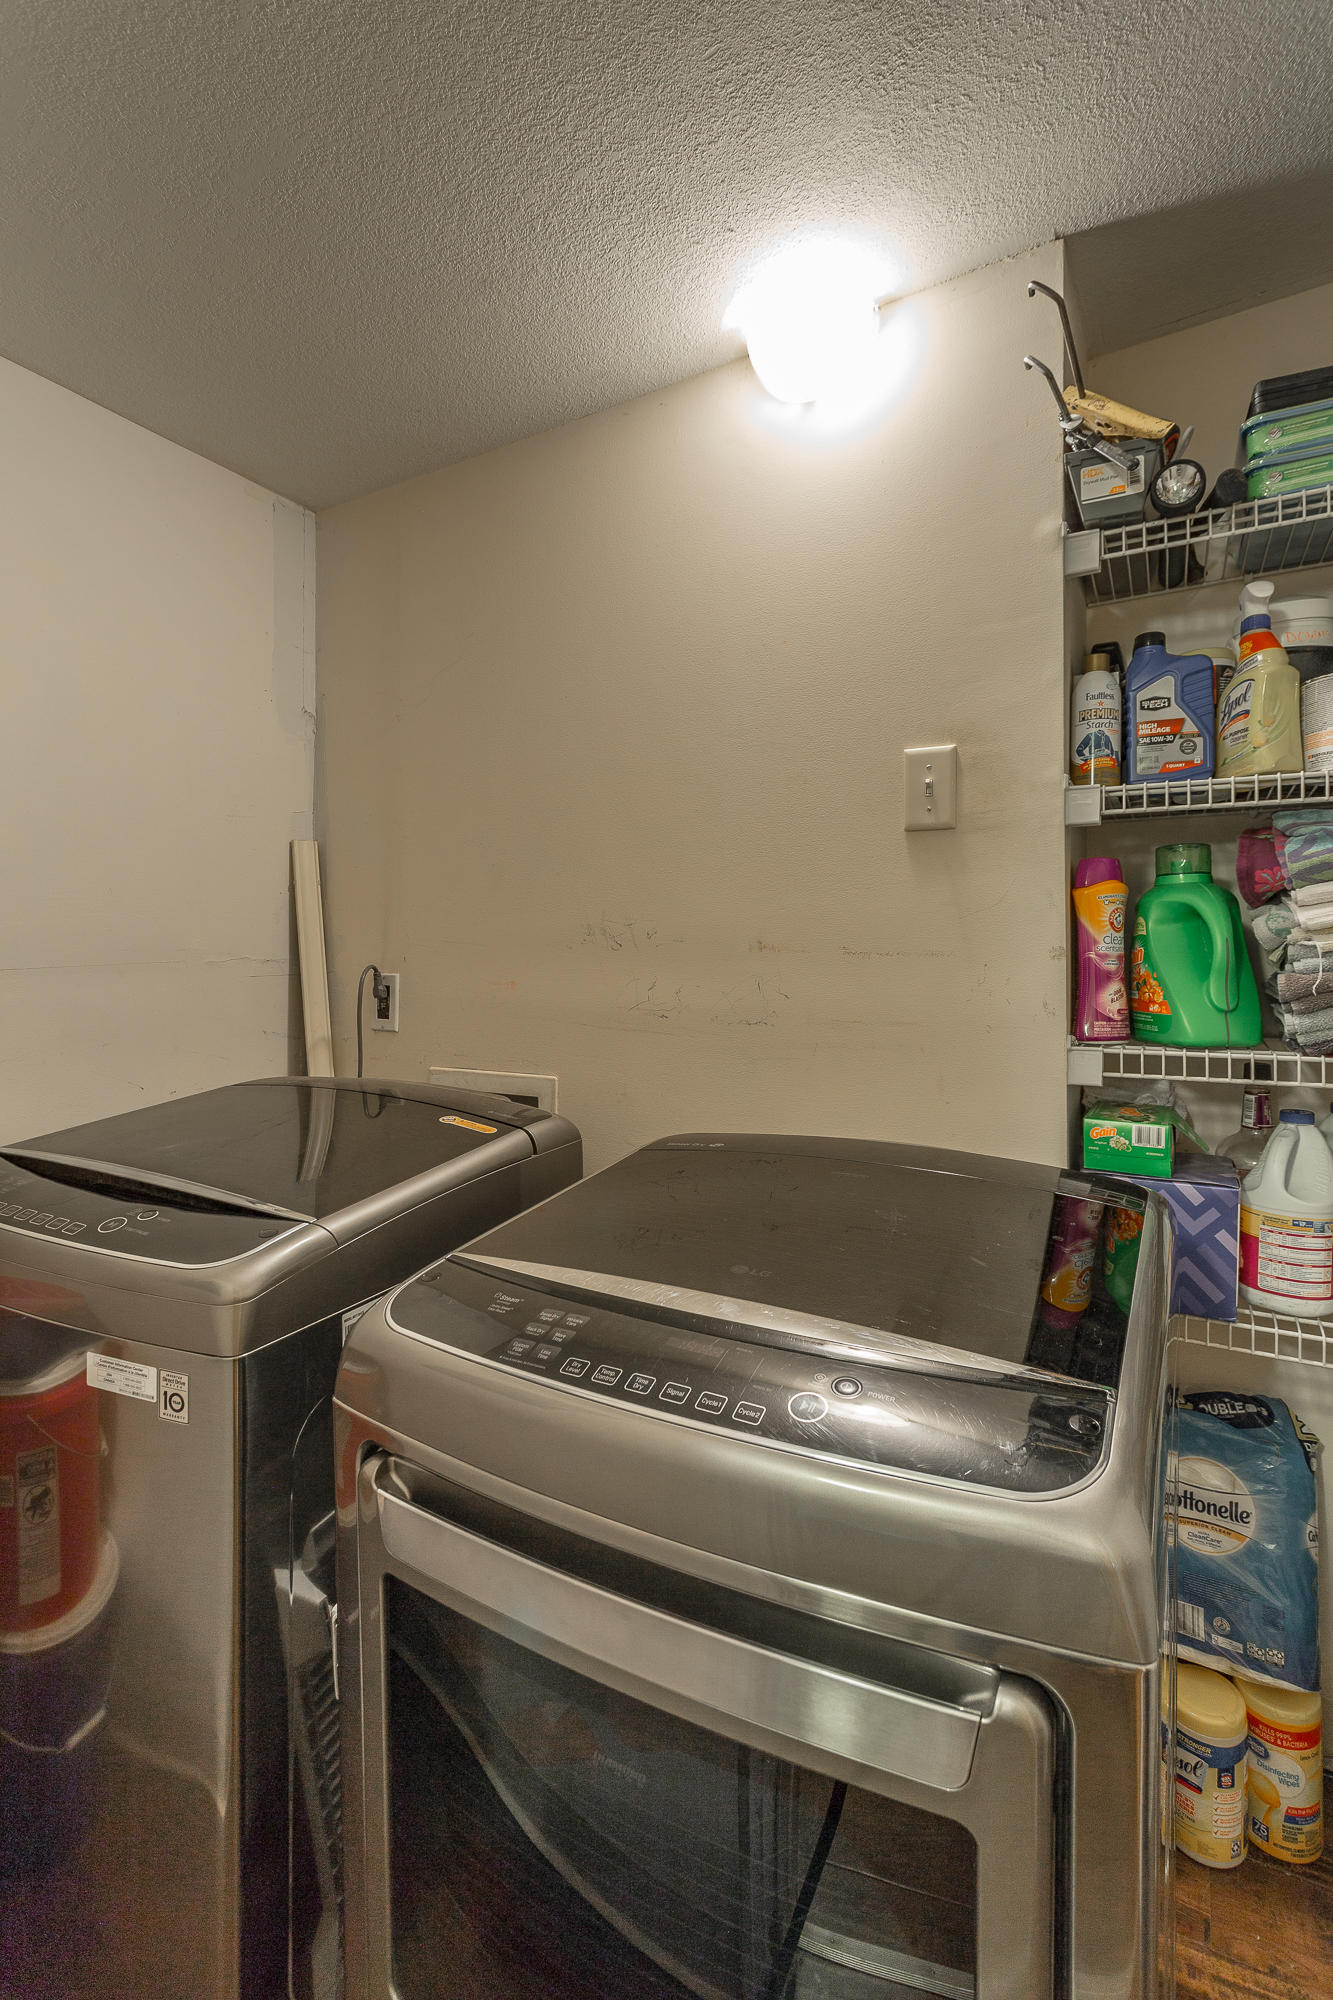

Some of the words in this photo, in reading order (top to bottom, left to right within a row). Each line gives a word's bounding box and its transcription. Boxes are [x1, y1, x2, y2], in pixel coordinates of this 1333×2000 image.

[1086, 692, 1115, 701] Faultless
[1079, 707, 1119, 722] PREMIUM
[1086, 720, 1113, 730] Starch
[1139, 727, 1171, 735] MILEAGE
[1090, 1127, 1117, 1139] Gain
[162, 1376, 174, 1384] Direct
[595, 1373, 615, 1382] Control
[636, 1377, 648, 1385] Time
[666, 1388, 685, 1397] Signal
[868, 1391, 896, 1401] POWER
[163, 1390, 185, 1413] 10
[163, 1412, 186, 1420] WARRANTY
[1179, 1520, 1208, 1528] SUPERIOR
[1211, 1525, 1232, 1536] CLEAN
[1188, 1532, 1221, 1544] CleanCare
[1259, 1725, 1274, 1736] KILLS
[1256, 1760, 1299, 1781] Disinfecting
[1278, 1776, 1300, 1788] Wipes
[1254, 1819, 1268, 1835] 75
